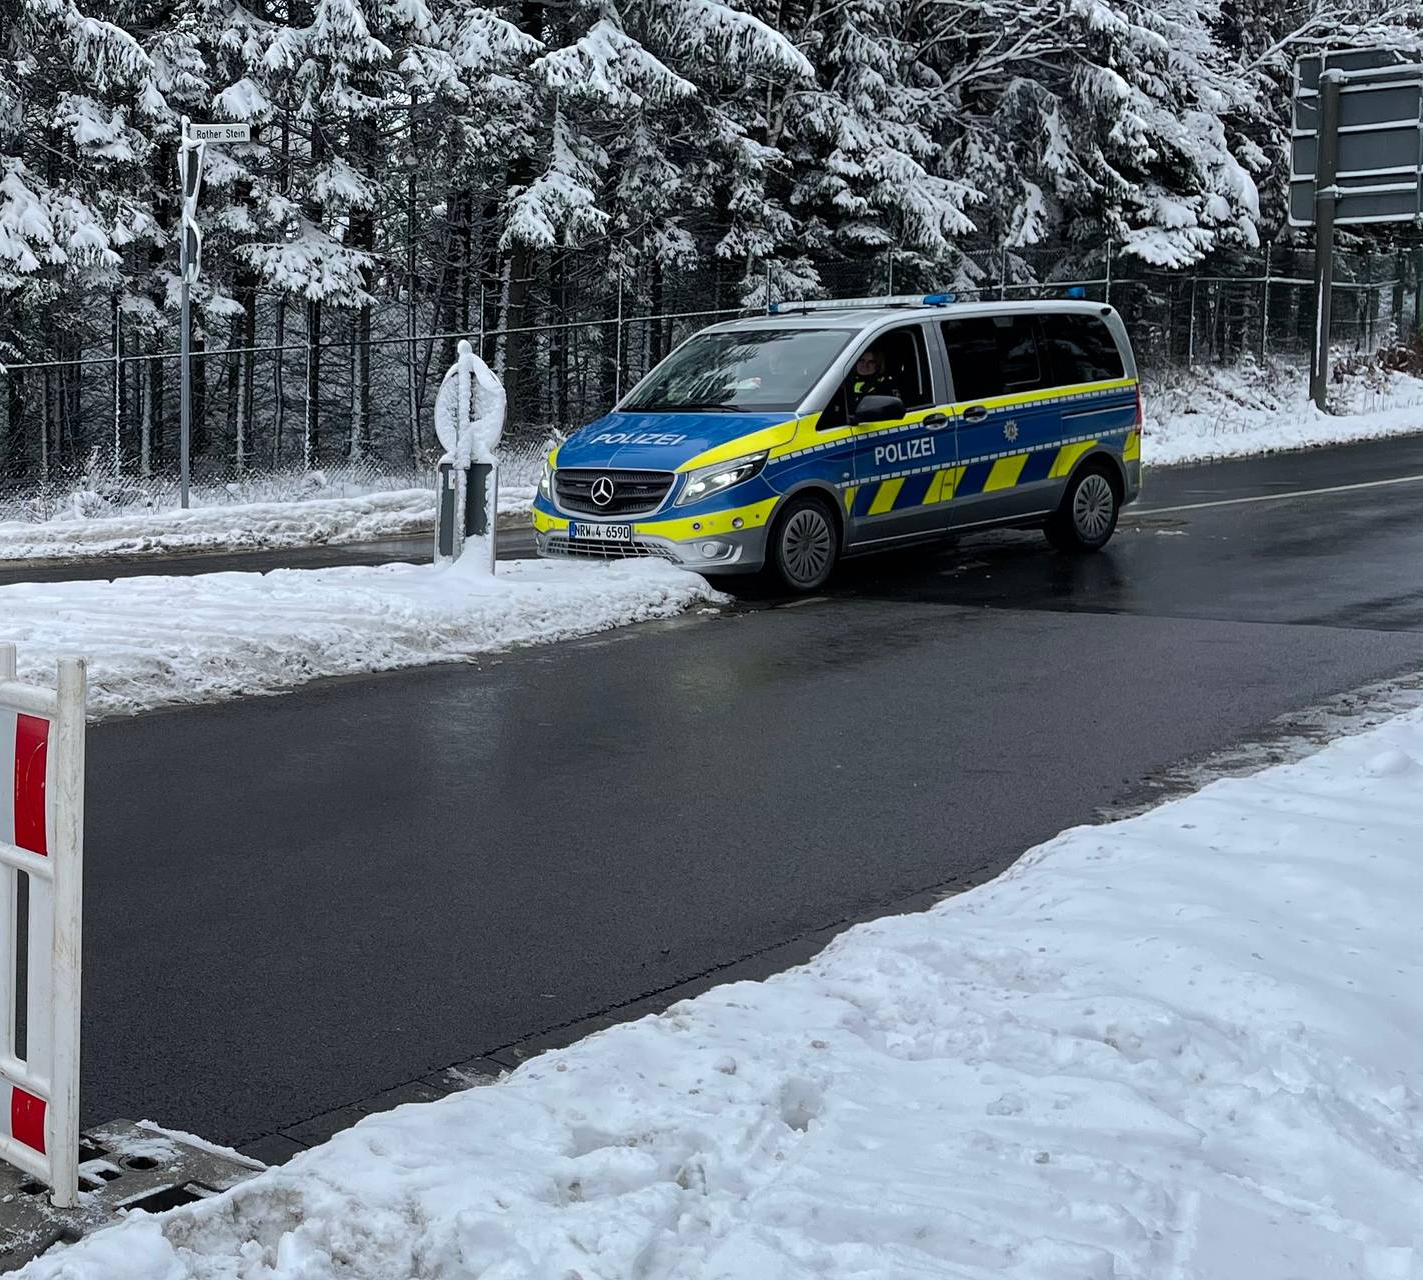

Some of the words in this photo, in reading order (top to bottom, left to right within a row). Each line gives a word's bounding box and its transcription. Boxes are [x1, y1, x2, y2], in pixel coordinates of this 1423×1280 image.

[197, 130, 222, 139] Rother
[225, 129, 245, 138] Stein
[589, 433, 688, 446] POLIZEI
[875, 437, 935, 465] POLIZEI
[575, 524, 591, 537] NRW
